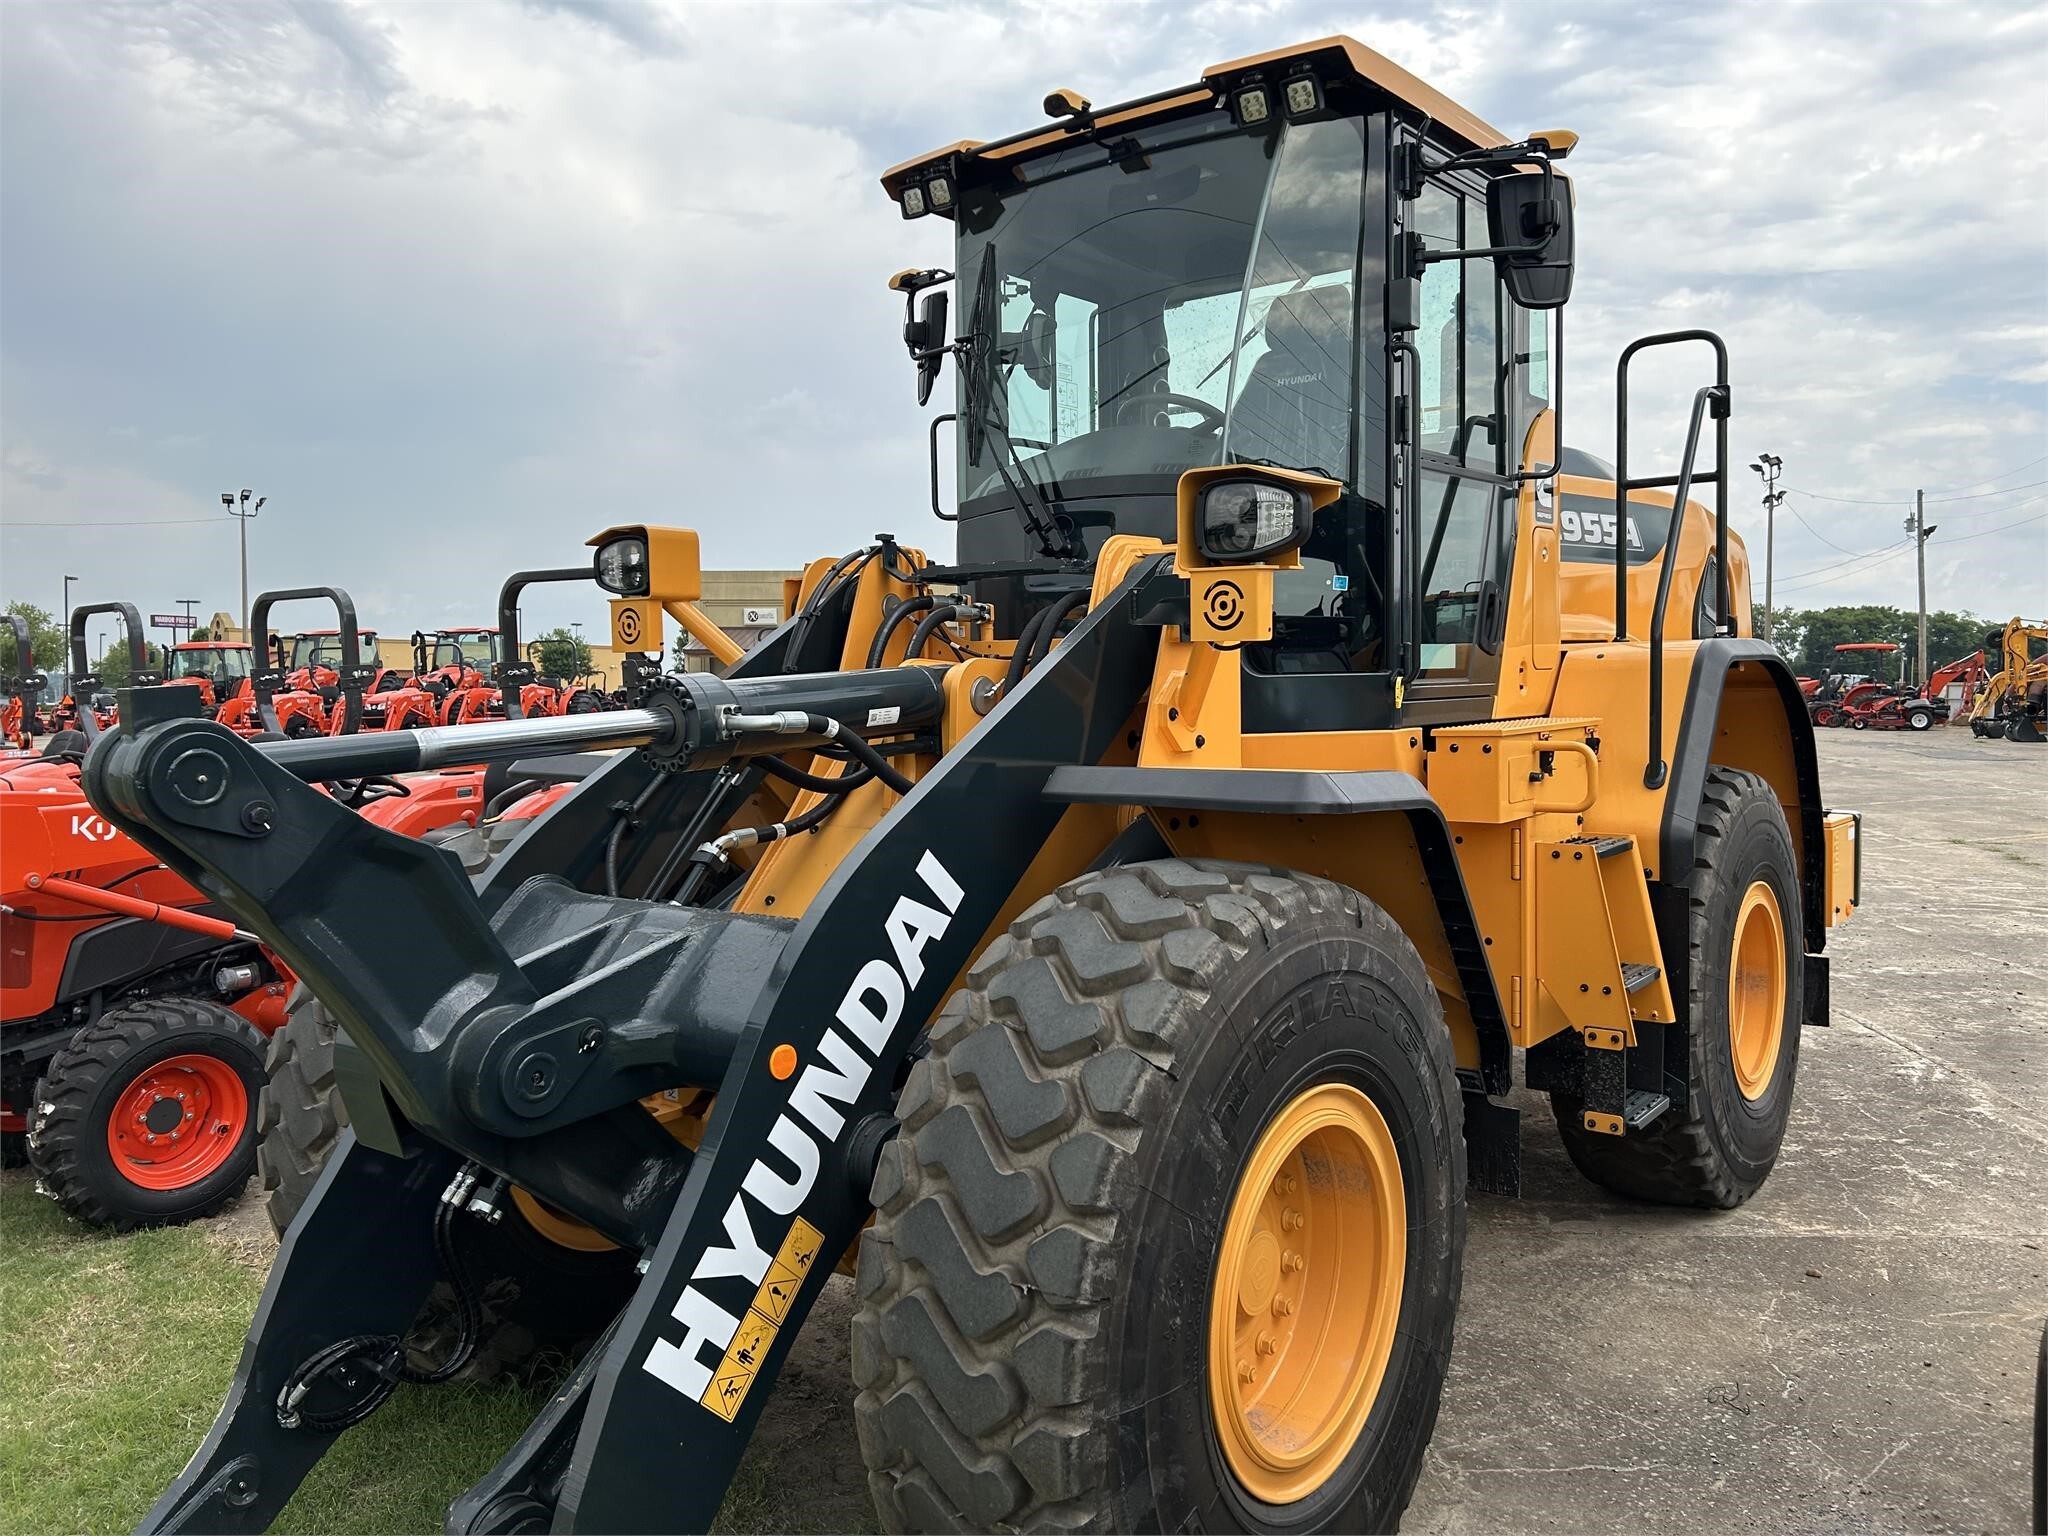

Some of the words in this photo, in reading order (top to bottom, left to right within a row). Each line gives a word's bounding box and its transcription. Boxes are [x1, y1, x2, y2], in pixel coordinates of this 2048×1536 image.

[1276, 371, 1323, 387] HYUNDAI
[1560, 510, 1642, 548] 955A
[641, 848, 966, 1404] HYUNDAI
